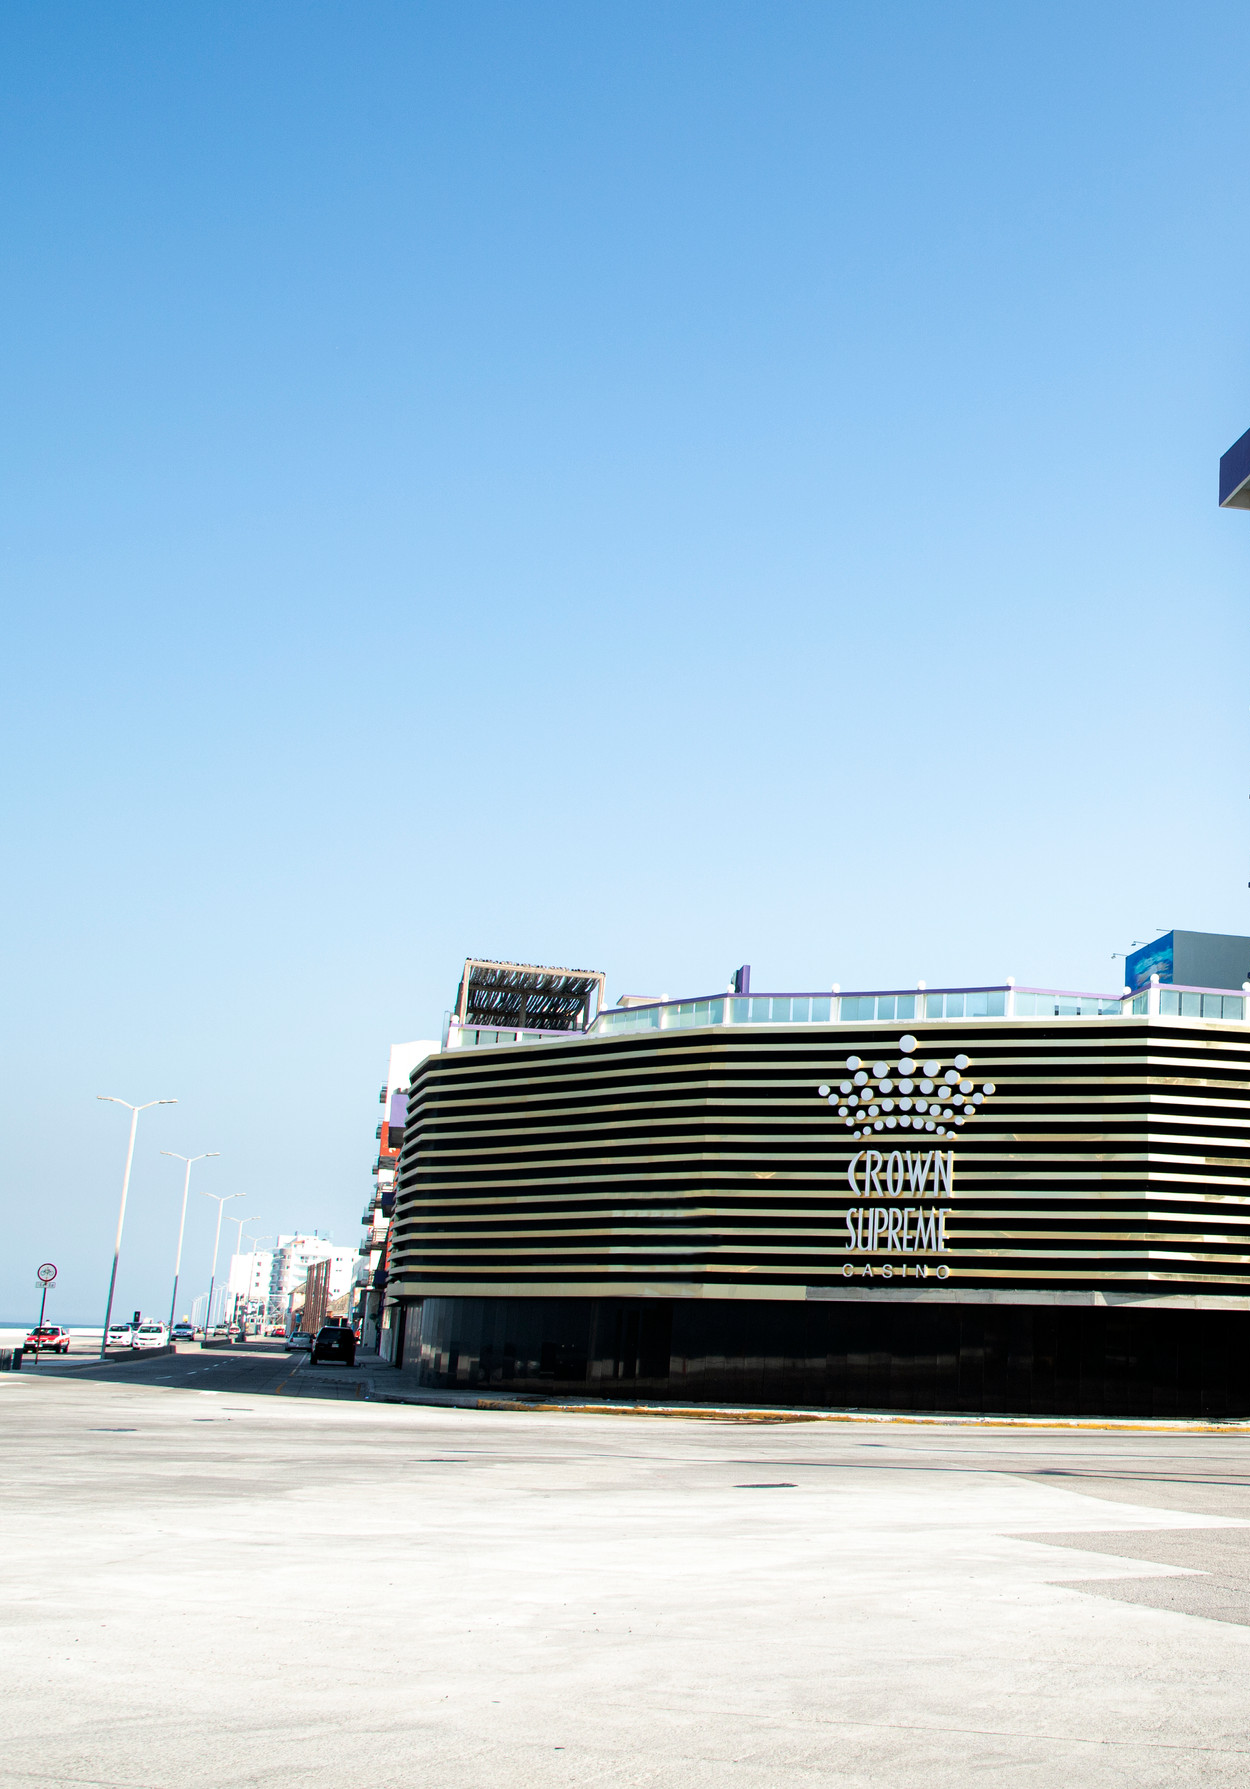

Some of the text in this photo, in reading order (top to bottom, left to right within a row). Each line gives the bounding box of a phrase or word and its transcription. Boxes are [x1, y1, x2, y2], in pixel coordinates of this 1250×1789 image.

[847, 1150, 953, 1198] CROWN
[845, 1206, 952, 1252] SUPREME
[842, 1263, 951, 1280] CASINO
